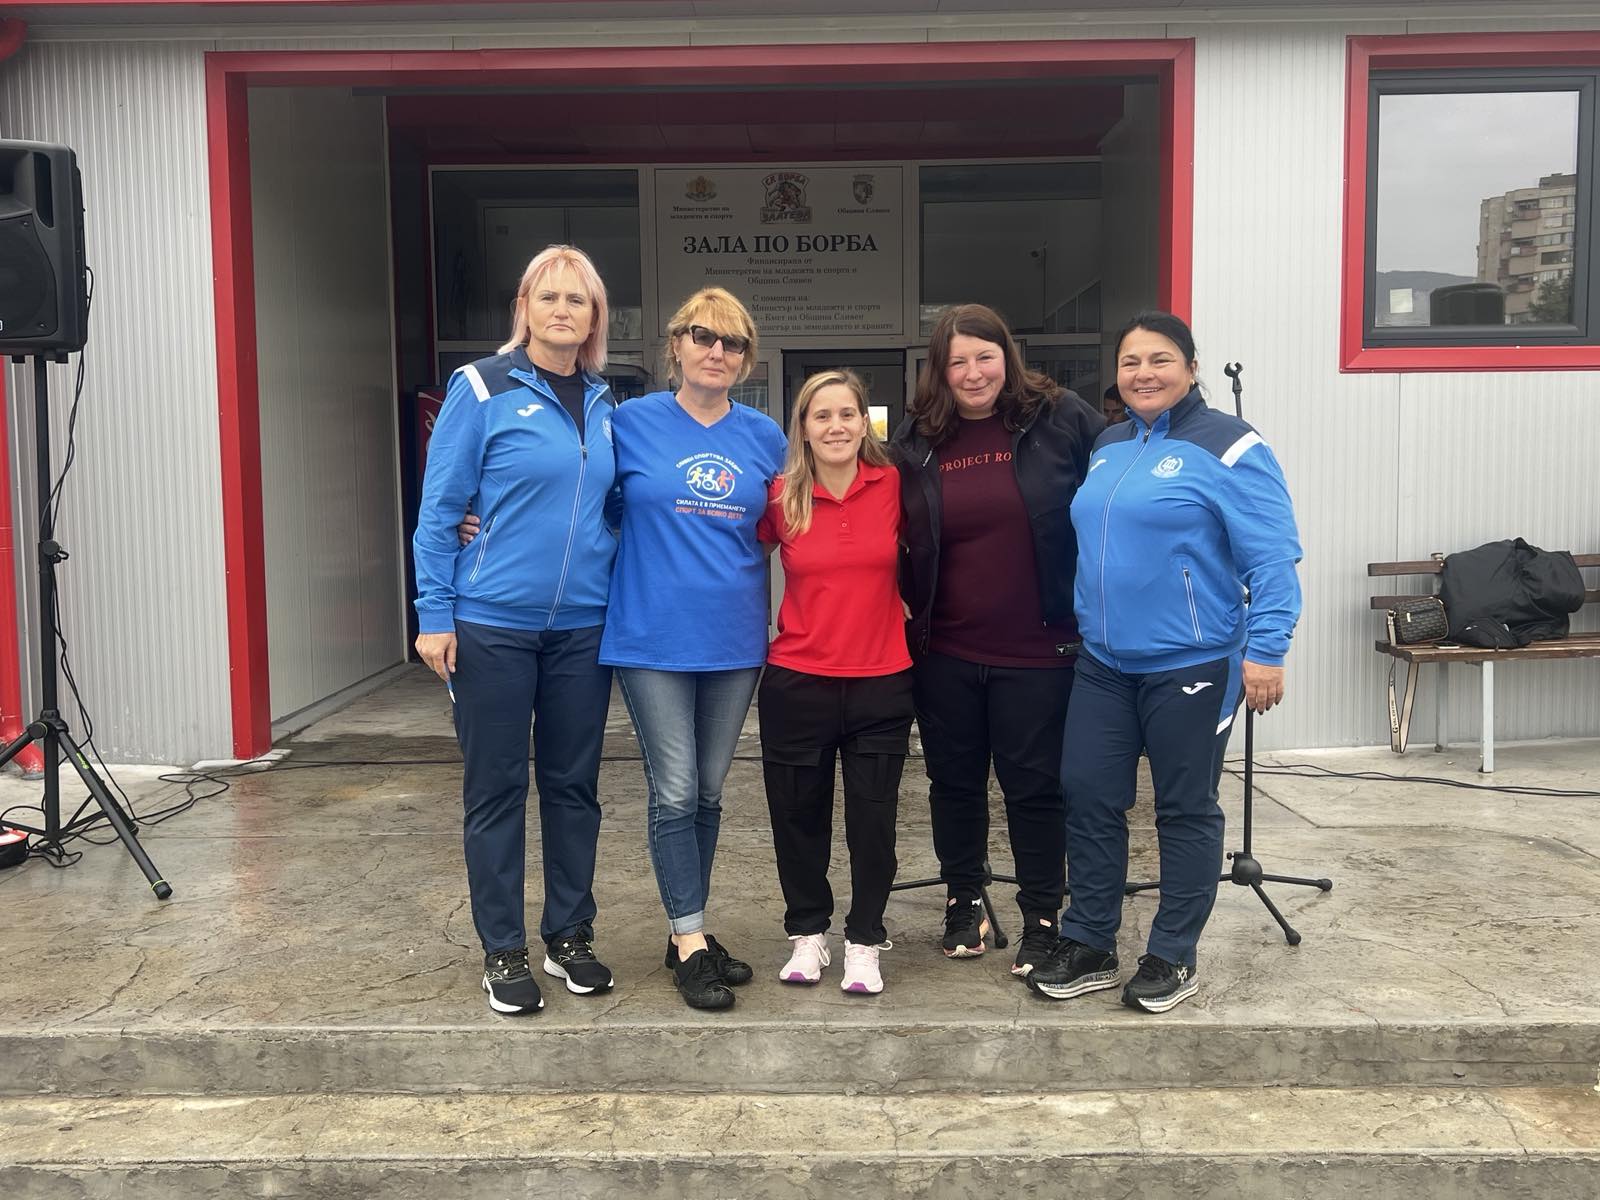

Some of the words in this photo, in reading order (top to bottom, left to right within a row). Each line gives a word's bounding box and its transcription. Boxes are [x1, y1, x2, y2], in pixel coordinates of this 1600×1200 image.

[684, 236, 748, 253] ЗАЛА
[753, 236, 789, 253] ПО
[796, 235, 878, 252] БОРБА
[747, 257, 802, 266] Финансирана
[705, 267, 761, 275] Министерство
[748, 276, 780, 285] Община
[782, 276, 812, 284] Сливен
[751, 304, 792, 312] Министър
[854, 304, 881, 312] спорта
[765, 313, 785, 321] Кмет
[799, 313, 832, 321] Община
[833, 312, 864, 321] Сливен
[861, 323, 893, 331] храните
[694, 453, 724, 461] СПОРТУВА
[939, 453, 990, 472] PROJECT
[709, 502, 747, 513] ПРИЕМАНЕТО
[675, 506, 696, 514] СПОРТ
[707, 509, 727, 517] ВСЯКО
[727, 511, 744, 519] ДЕТЕ
